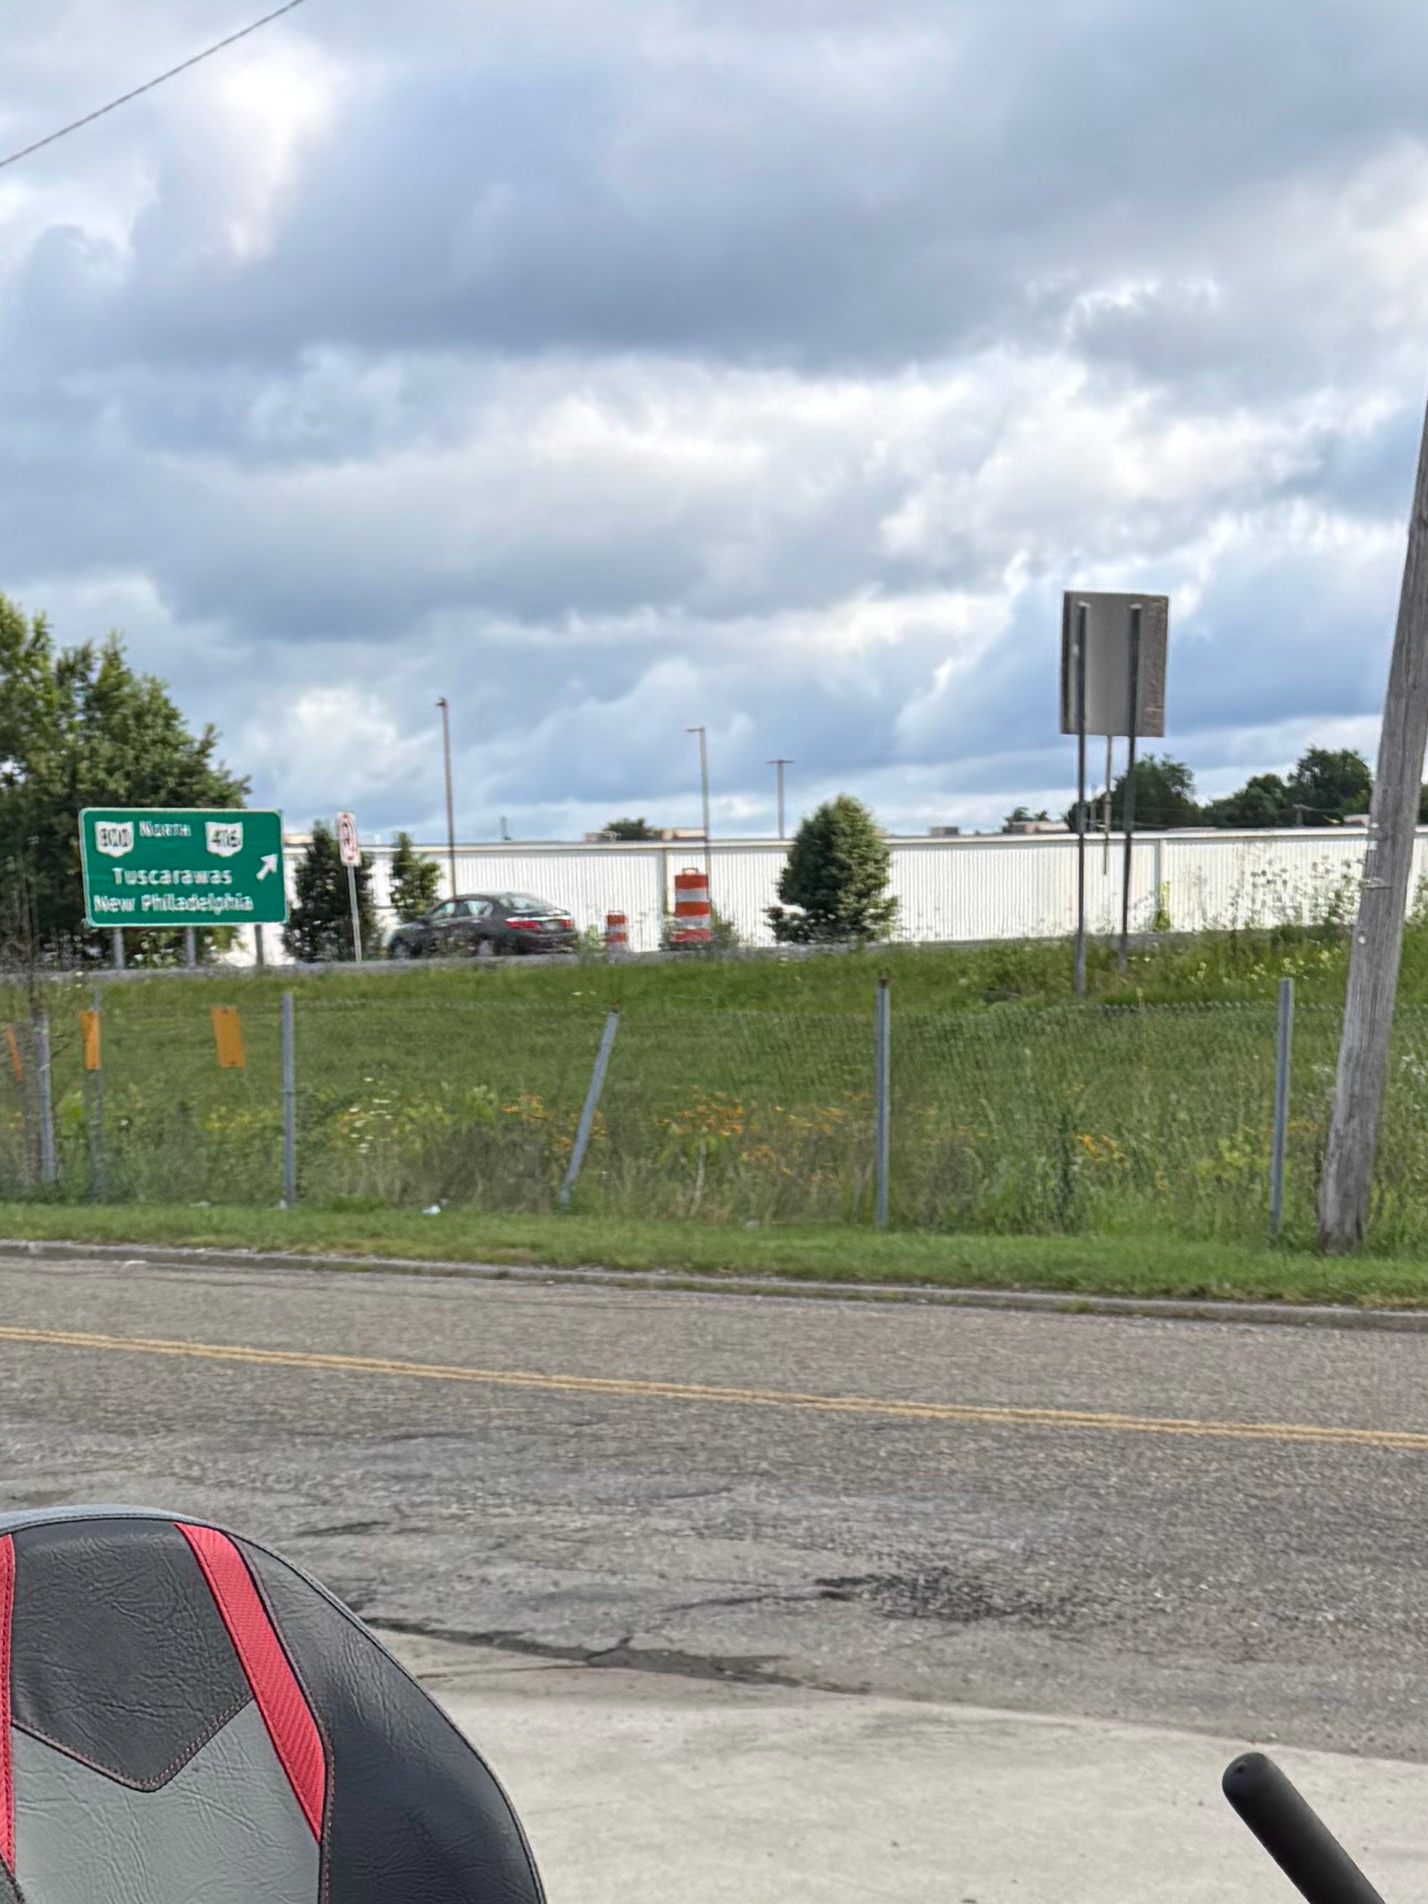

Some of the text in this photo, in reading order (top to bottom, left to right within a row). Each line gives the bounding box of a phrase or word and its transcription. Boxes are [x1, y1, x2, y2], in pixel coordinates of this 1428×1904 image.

[112, 867, 233, 886] Tuscarawas
[94, 892, 254, 915] New Philadelphia
